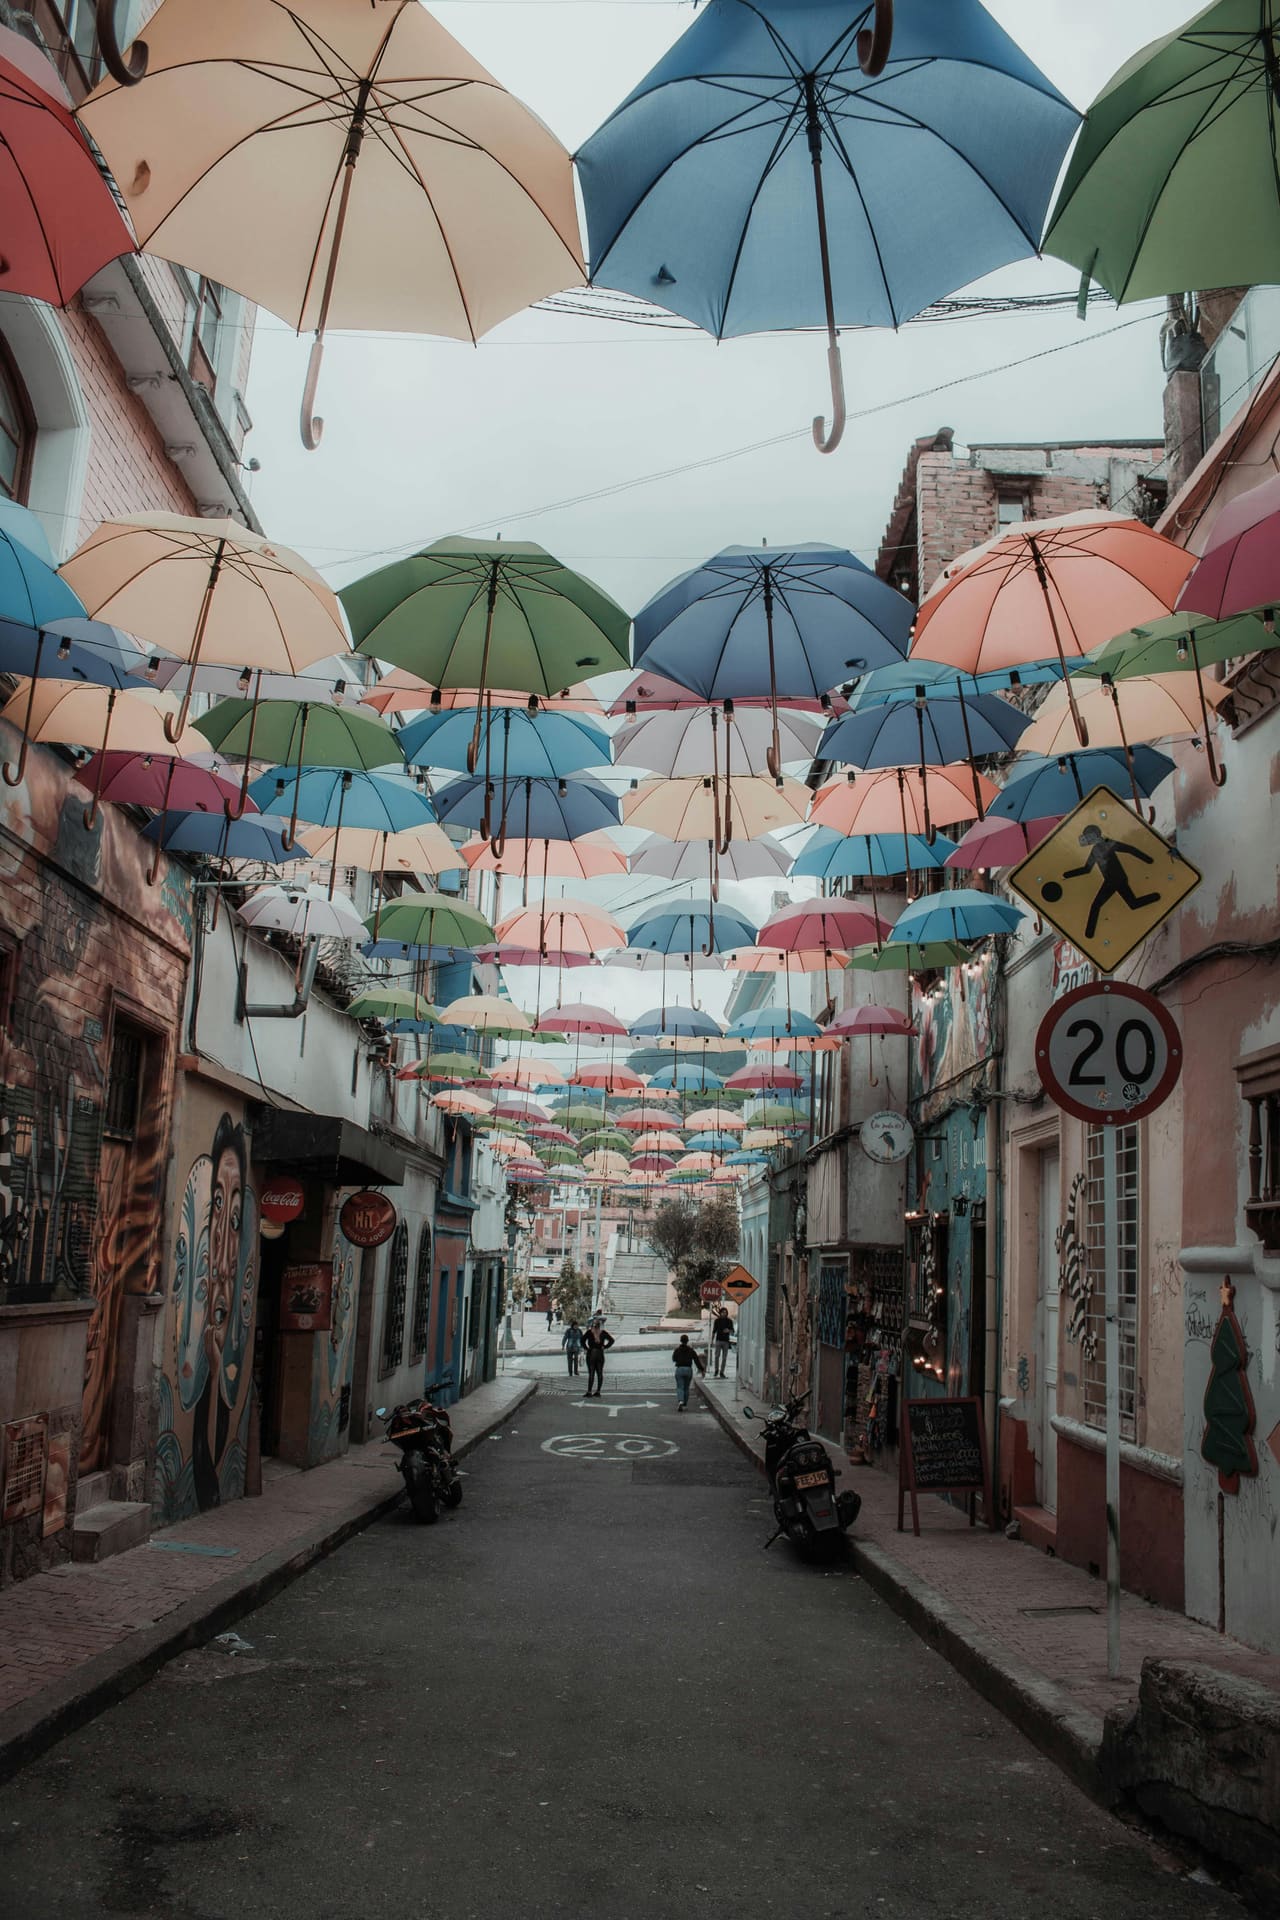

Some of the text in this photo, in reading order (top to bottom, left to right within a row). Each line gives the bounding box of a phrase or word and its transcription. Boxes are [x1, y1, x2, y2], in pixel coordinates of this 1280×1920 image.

[1067, 1019, 1155, 1085] 20
[703, 1286, 720, 1296] PARE
[557, 1437, 654, 1454] 20
